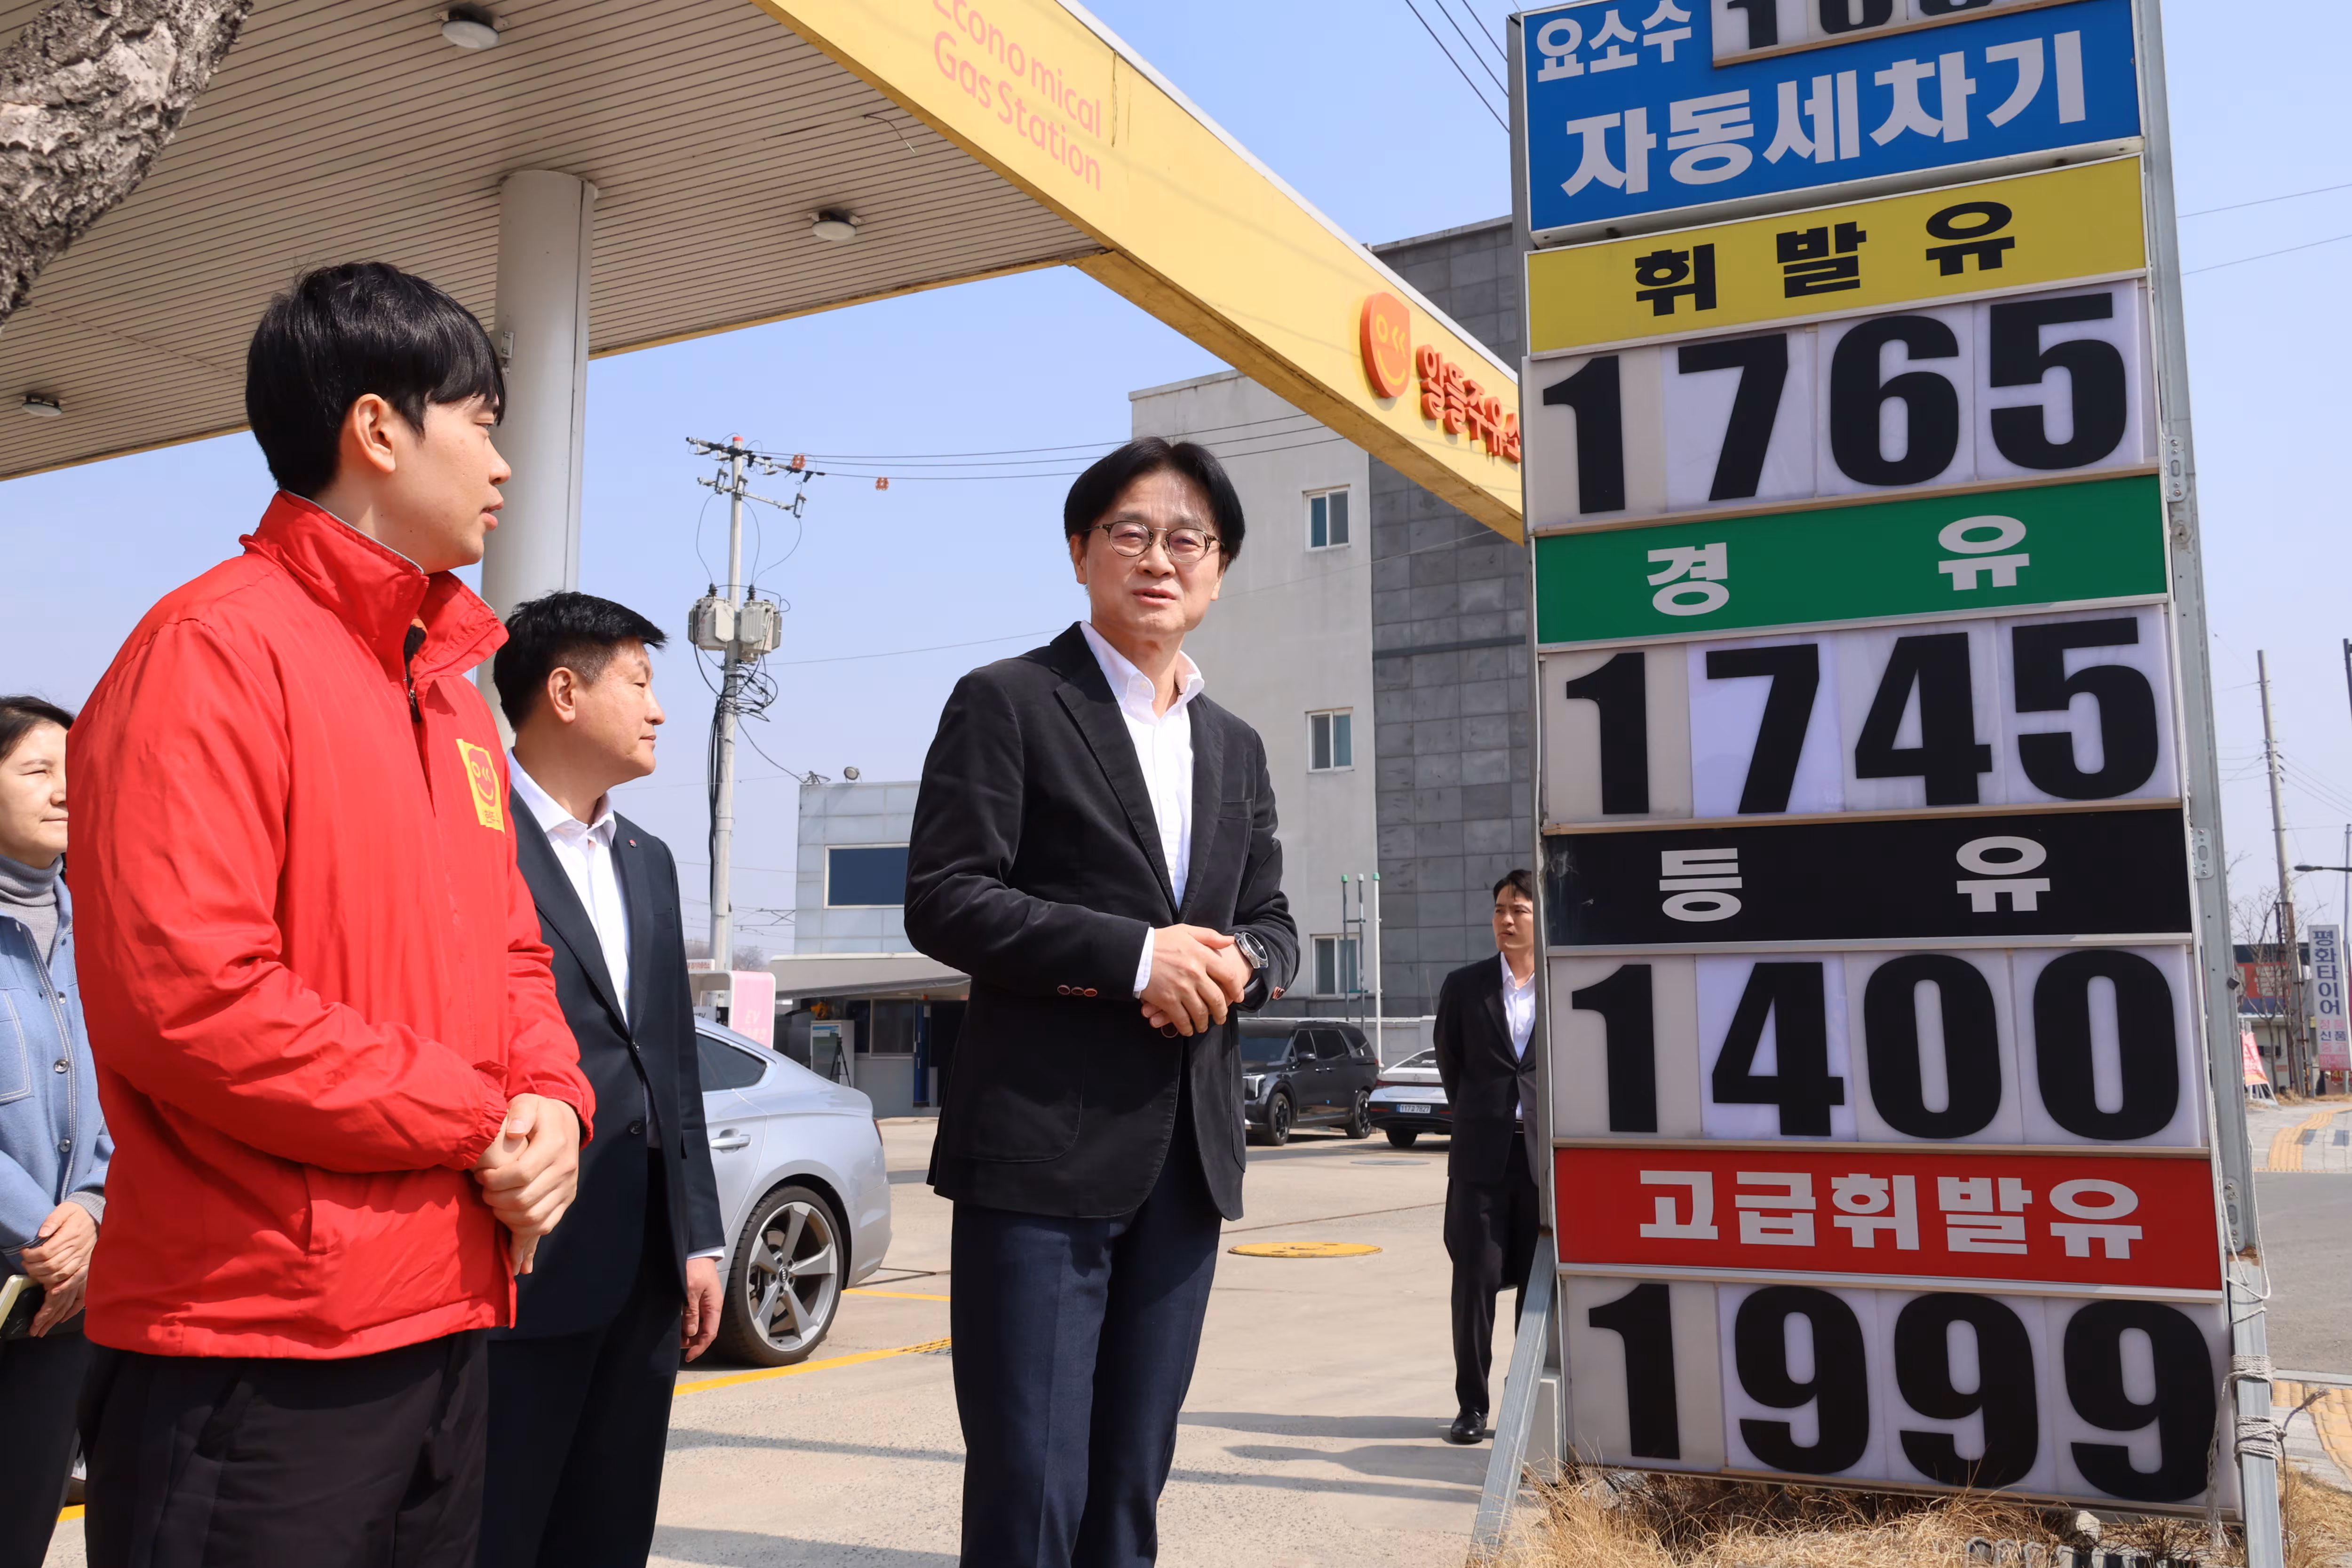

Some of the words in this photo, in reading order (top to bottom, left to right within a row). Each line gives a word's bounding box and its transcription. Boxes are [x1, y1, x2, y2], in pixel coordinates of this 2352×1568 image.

[1537, 0, 1692, 82] 요소수
[934, 31, 991, 109] Gas
[997, 79, 1100, 191] Station
[1560, 30, 2085, 197] 자동세차기
[1635, 201, 2015, 317] 휘발유
[1542, 292, 2127, 515] 1765
[1647, 515, 2030, 617] 경유
[1566, 617, 2159, 815] 1745
[1659, 836, 2050, 922] 등유
[2312, 930, 2340, 1015] 평화타이어
[1572, 949, 2180, 1140] 1400
[1640, 1170, 2143, 1259] 고급휘발유
[1588, 1283, 2217, 1503] 1999
